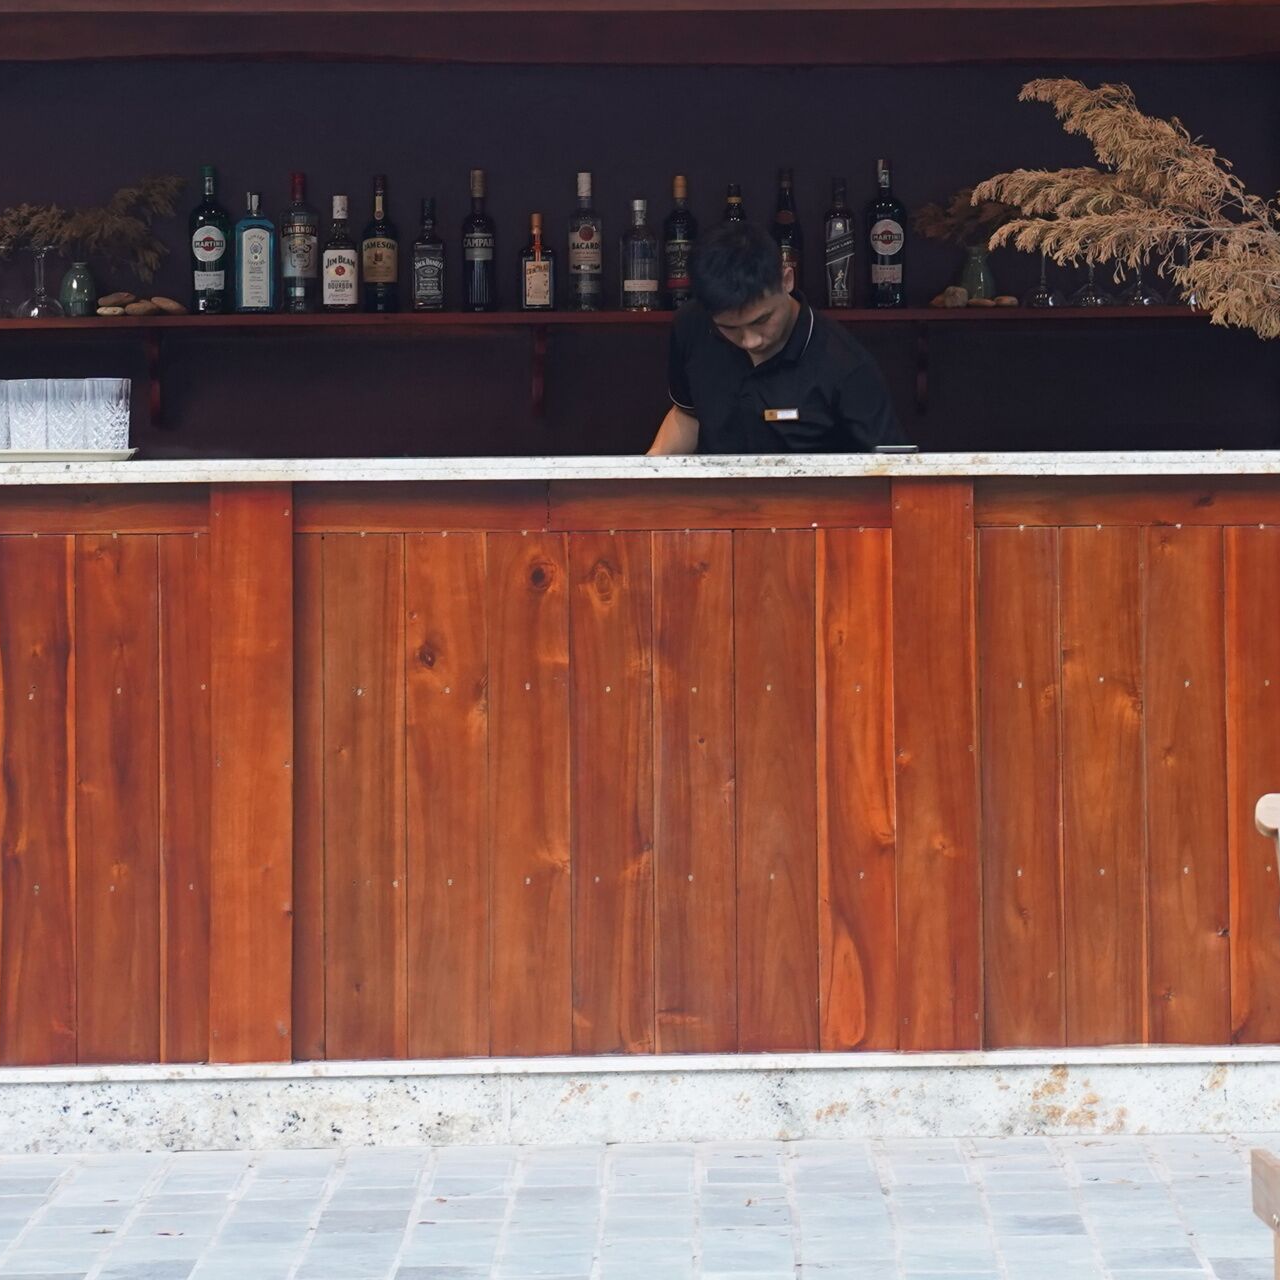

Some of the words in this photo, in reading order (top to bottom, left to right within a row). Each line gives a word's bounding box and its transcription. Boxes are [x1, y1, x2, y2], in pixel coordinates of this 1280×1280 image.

[872, 233, 902, 241] MARTINI
[194, 240, 224, 248] MARTINI
[363, 241, 397, 251] JAMESON
[325, 258, 337, 269] JIM
[338, 255, 355, 268] BEAM
[328, 282, 353, 290] BOURBON
